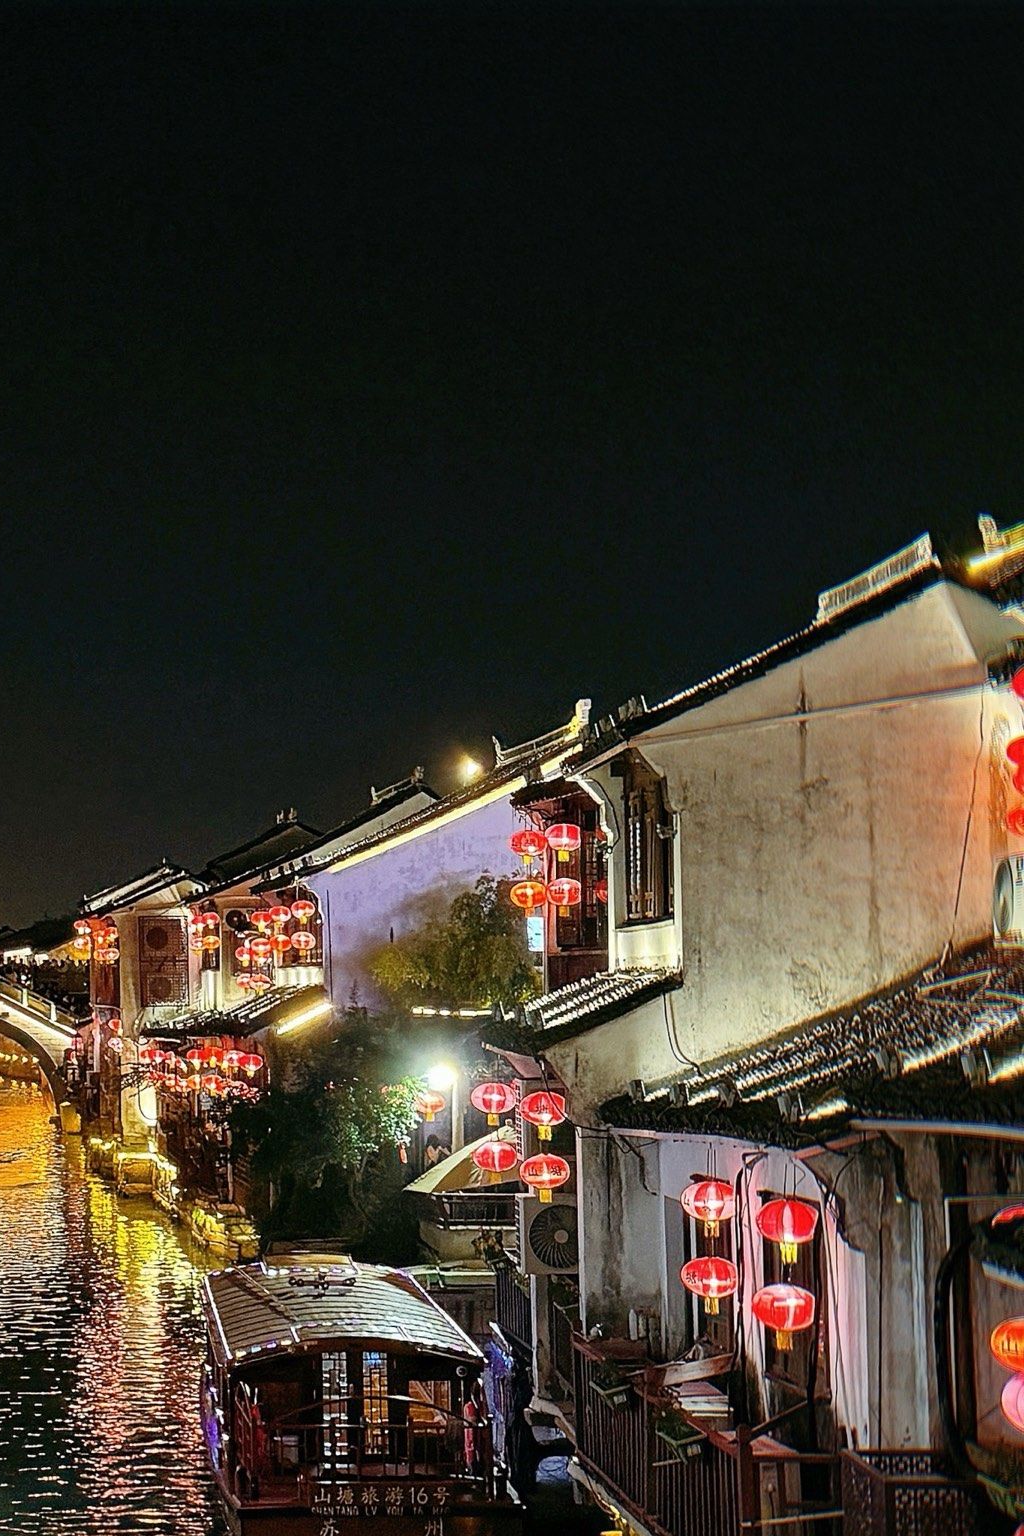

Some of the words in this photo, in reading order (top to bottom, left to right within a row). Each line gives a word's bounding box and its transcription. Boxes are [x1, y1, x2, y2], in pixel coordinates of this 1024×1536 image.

[314, 1486, 451, 1505] 山塘旅游16号
